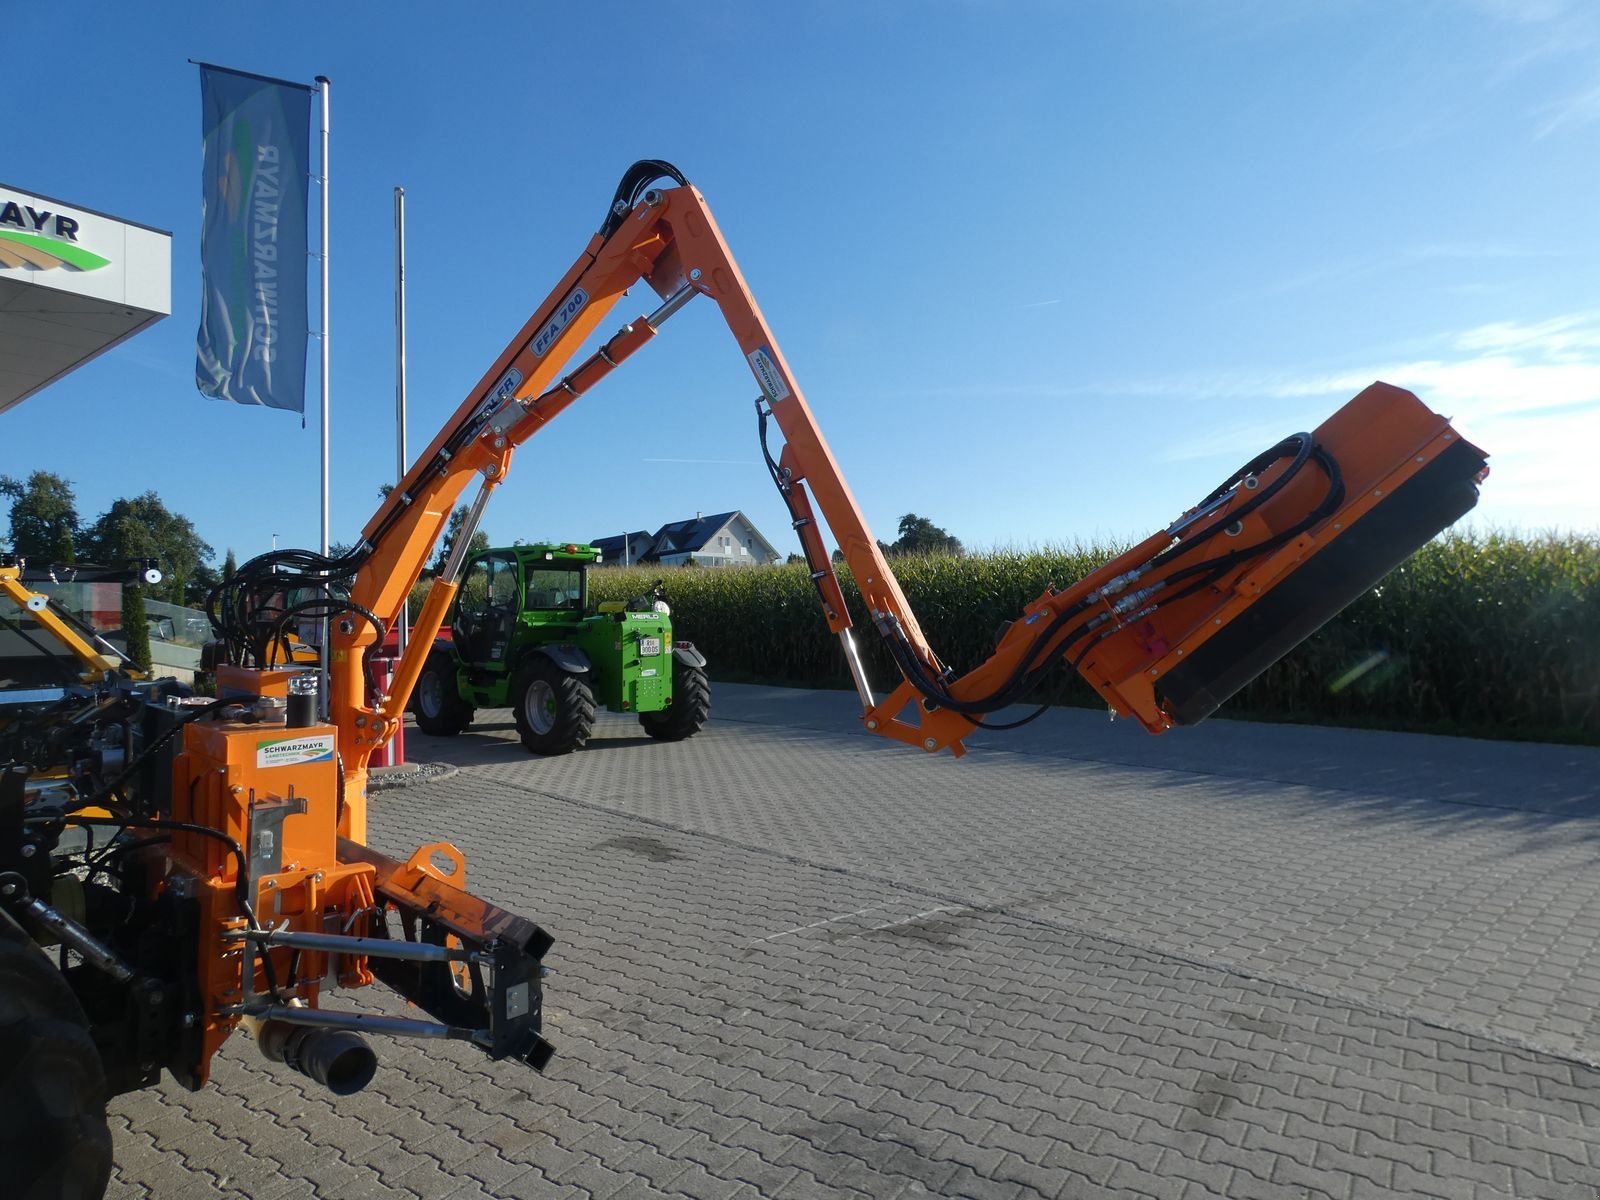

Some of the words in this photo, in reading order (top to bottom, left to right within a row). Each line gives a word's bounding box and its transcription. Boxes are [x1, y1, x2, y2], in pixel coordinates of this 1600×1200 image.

[536, 323, 560, 353] FFA
[560, 293, 583, 322] 700
[756, 358, 778, 398] SCHWARZMAYR
[264, 743, 323, 753] SCHWARZMAYR
